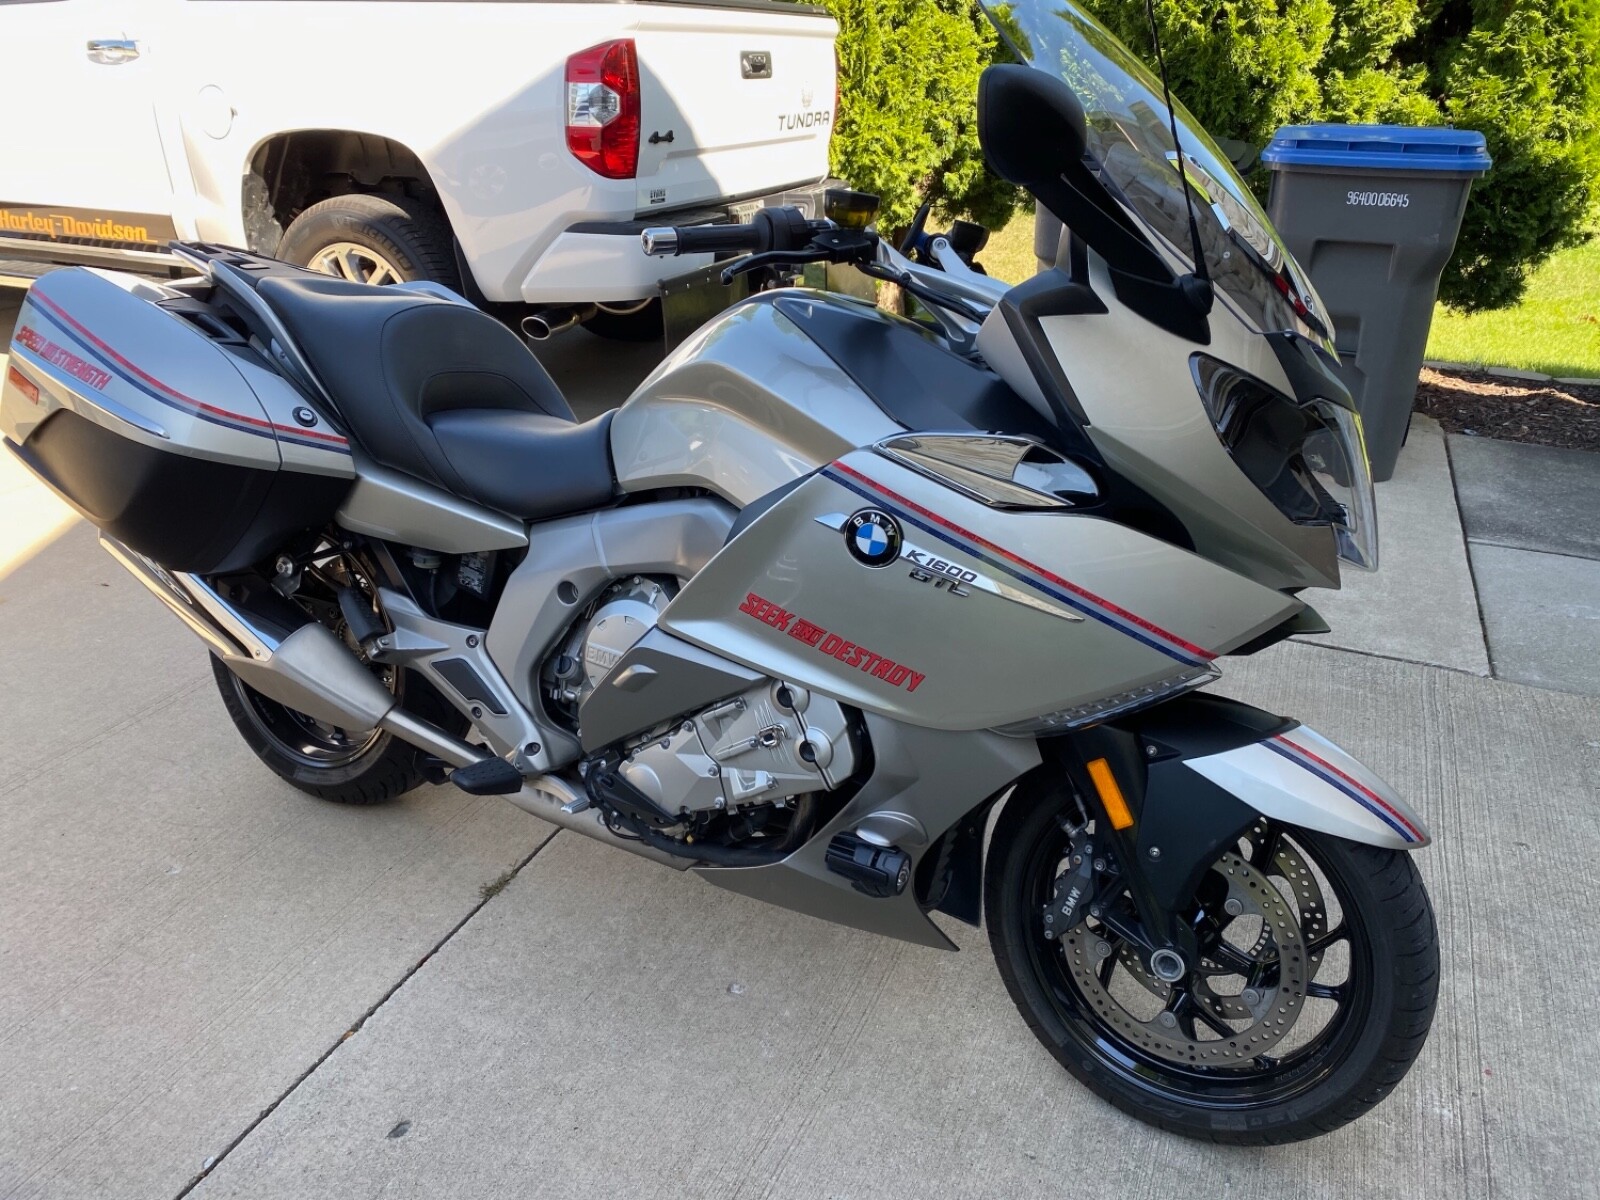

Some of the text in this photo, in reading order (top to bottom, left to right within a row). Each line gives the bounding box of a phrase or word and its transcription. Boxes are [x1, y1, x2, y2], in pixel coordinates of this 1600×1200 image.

[778, 110, 830, 131] TUNDRA
[853, 513, 896, 536] BMW
[906, 549, 978, 583] K 1600
[739, 592, 926, 693] SEEK AND DESTROY
[1061, 886, 1081, 917] BMW
